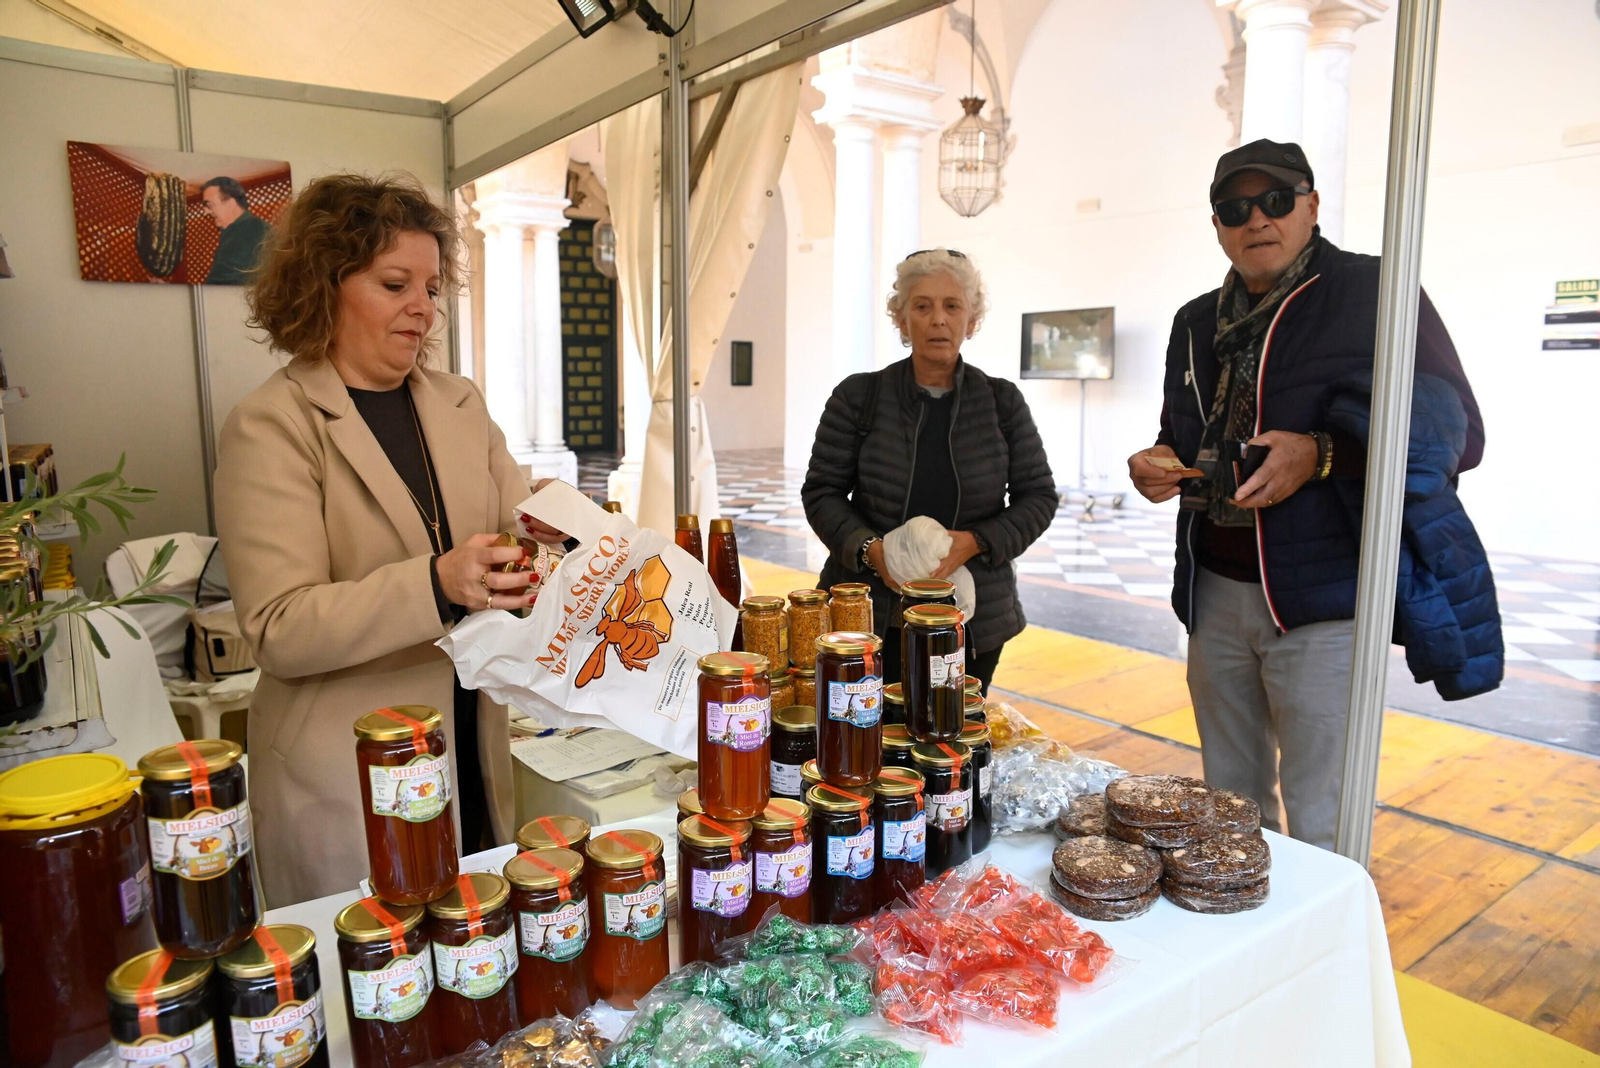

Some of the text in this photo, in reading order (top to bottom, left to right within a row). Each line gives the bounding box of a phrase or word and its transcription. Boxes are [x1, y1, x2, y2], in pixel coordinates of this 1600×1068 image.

[1558, 281, 1598, 291] SALIDA
[566, 623, 580, 641] DE
[577, 581, 607, 622] SIERRA
[603, 536, 630, 580] MORENA
[678, 581, 693, 615] Jalea Real
[685, 603, 695, 618] Miel
[692, 604, 702, 621] Polen
[706, 613, 714, 628] Cera
[725, 702, 767, 713] MIELSICO
[392, 759, 444, 779] MIELSICO
[169, 811, 236, 833] MIELSICO
[196, 855, 221, 866] Miel de
[199, 862, 219, 872] Brezo
[540, 901, 587, 924] MIELSICO
[452, 936, 506, 958] MIELSICO
[559, 941, 570, 949] Miel
[370, 954, 425, 983] MIELSICO
[473, 979, 485, 987] Miel
[255, 1000, 316, 1031] MIELSICO
[121, 1038, 190, 1059] MIELSICO
